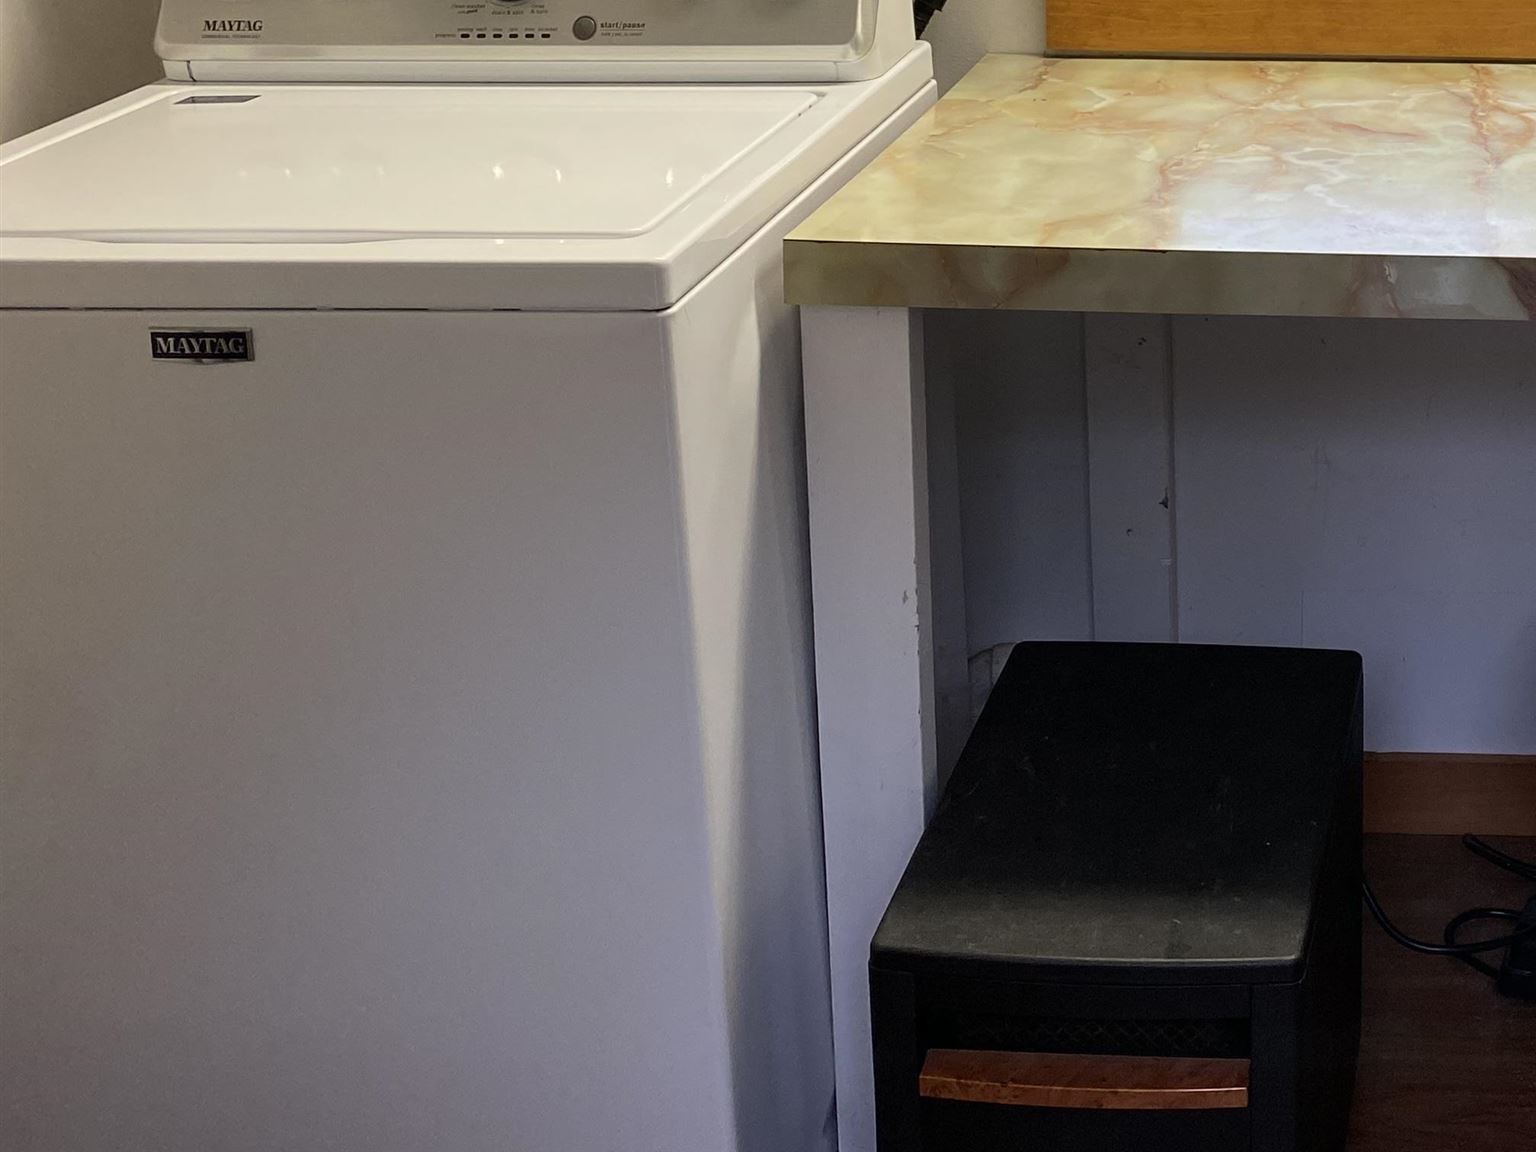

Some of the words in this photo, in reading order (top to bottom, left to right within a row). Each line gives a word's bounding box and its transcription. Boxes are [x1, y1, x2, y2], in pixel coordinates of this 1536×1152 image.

[202, 19, 264, 32] MAYTAG
[600, 21, 646, 31] start/pause
[155, 336, 245, 355] MAYTAG
